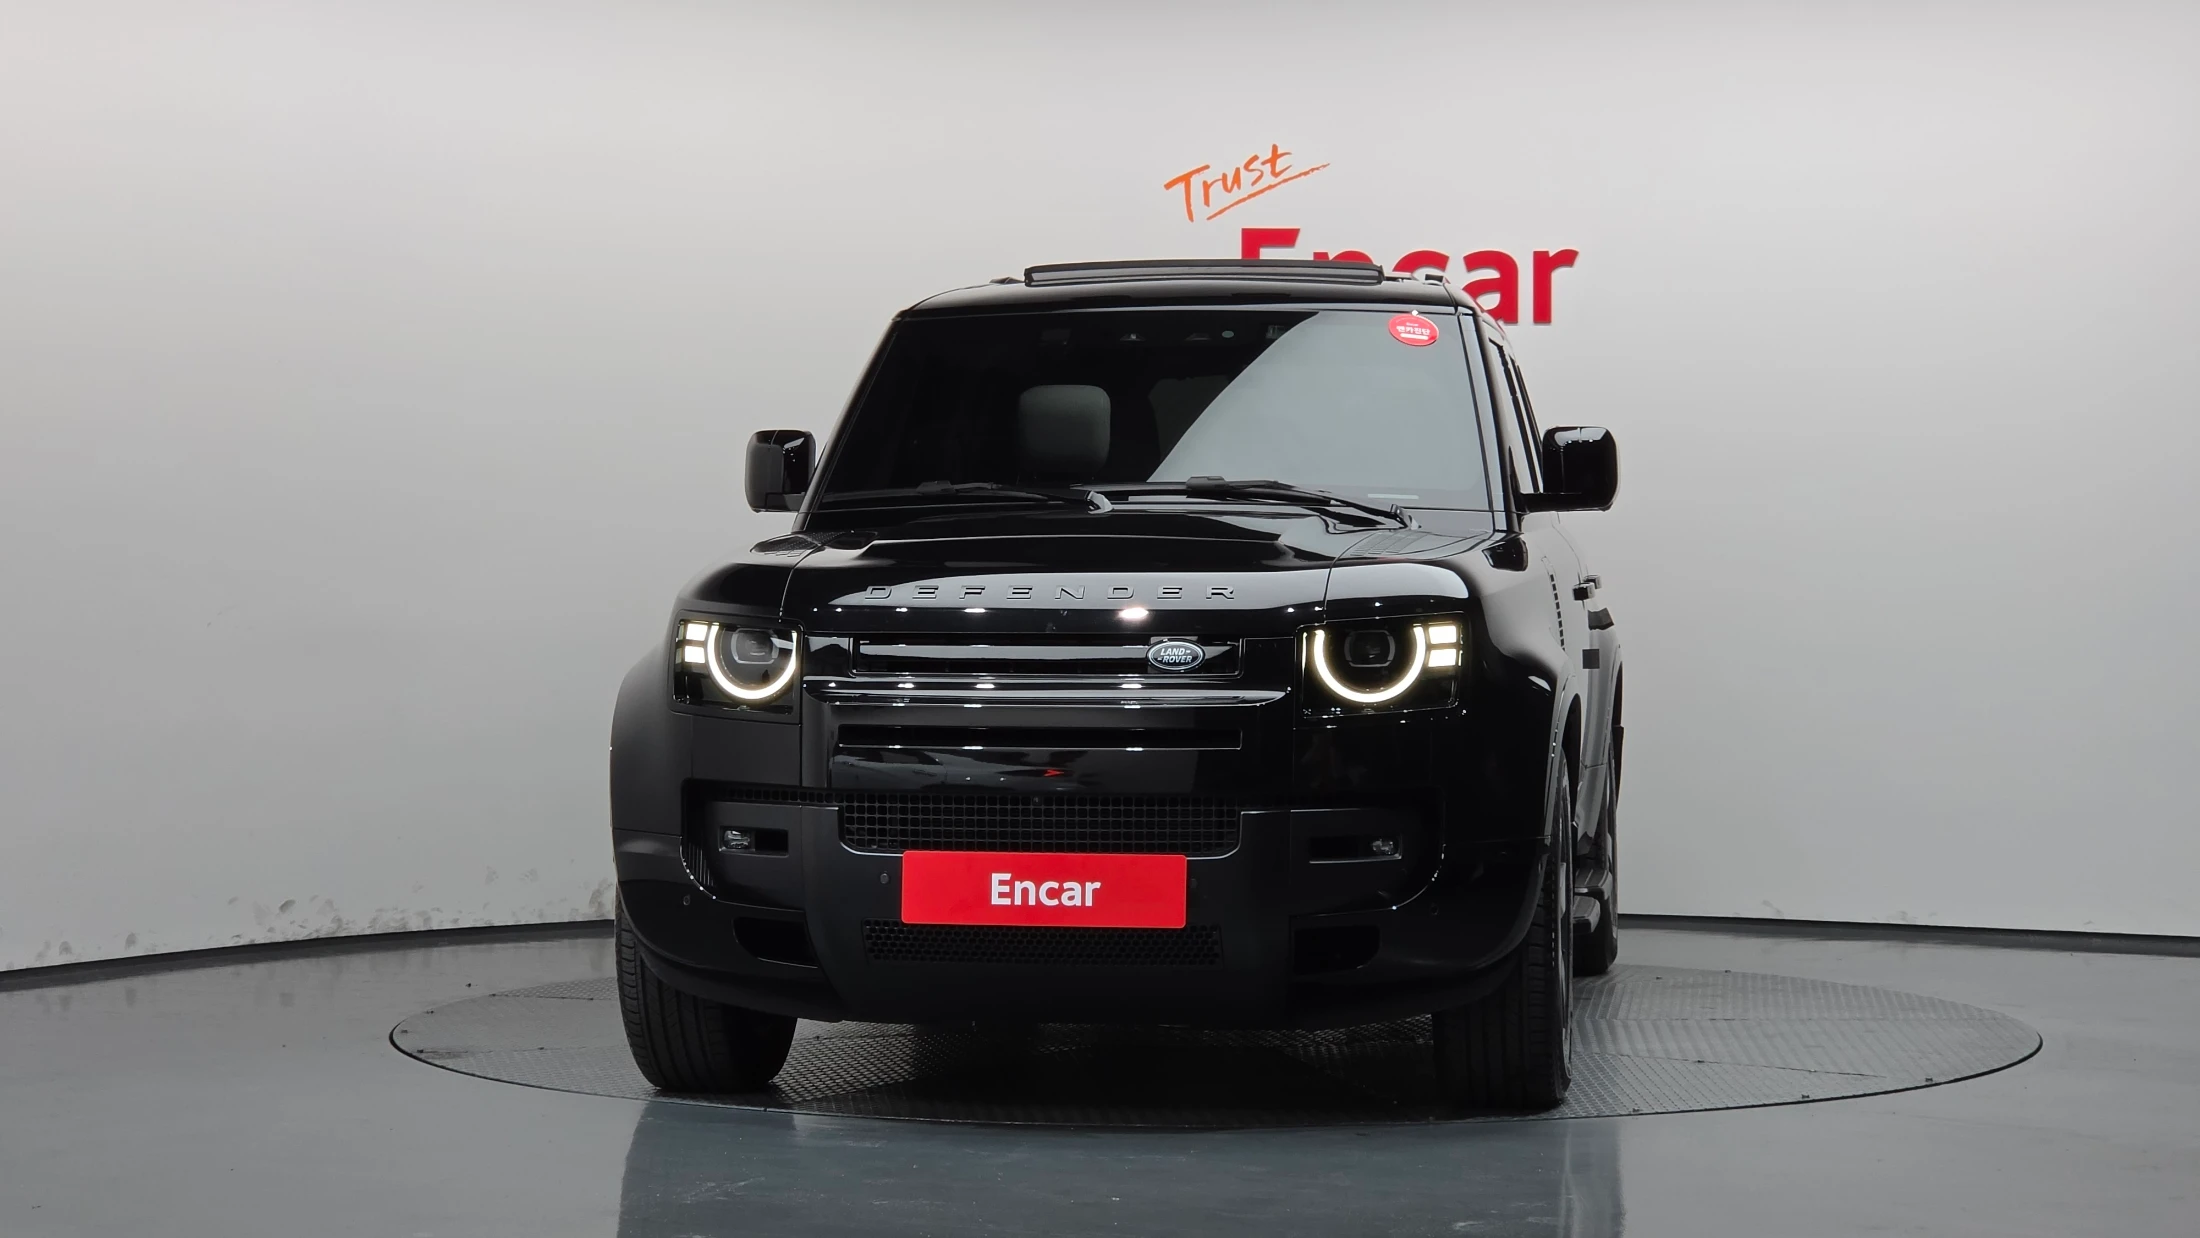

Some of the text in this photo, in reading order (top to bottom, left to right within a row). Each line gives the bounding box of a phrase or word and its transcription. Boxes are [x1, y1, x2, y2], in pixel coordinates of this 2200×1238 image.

[1163, 143, 1292, 222] Trust
[864, 585, 1236, 600] DEFENDER
[990, 872, 1102, 907] Encar
